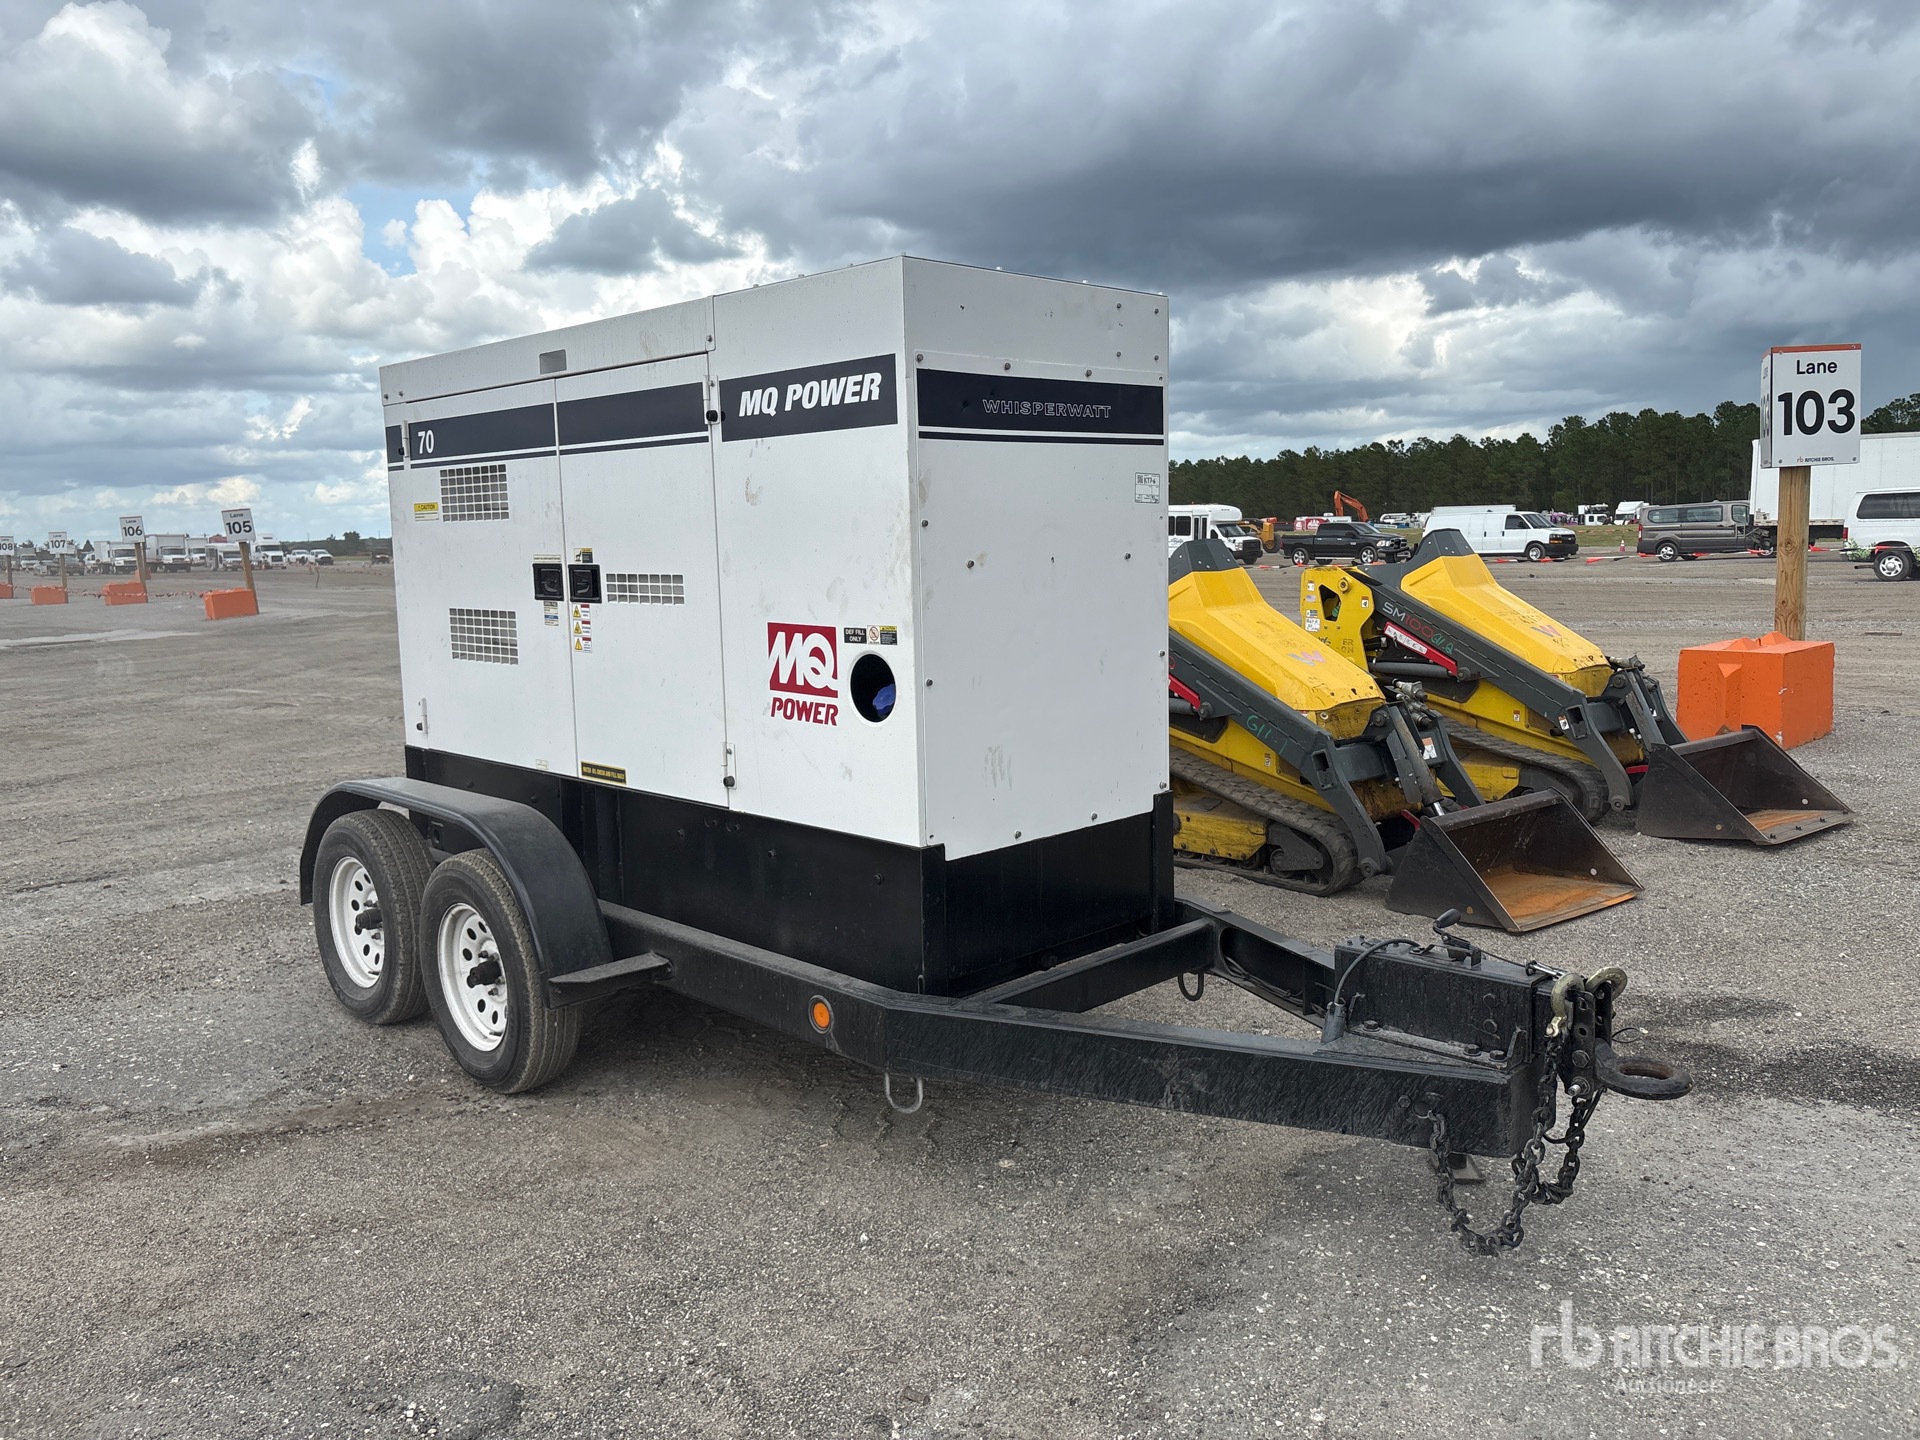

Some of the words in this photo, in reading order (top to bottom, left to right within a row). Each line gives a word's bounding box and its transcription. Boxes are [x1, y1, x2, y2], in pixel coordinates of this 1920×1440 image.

[1796, 359, 1838, 375] Lane
[738, 386, 779, 417] MQ
[784, 371, 882, 412] POWER
[982, 399, 1112, 419] WHISPERWATT
[1777, 388, 1856, 436] 103
[417, 429, 435, 455] 70
[122, 525, 143, 537] 106
[225, 520, 253, 535] 105
[50, 539, 66, 549] 107
[1382, 601, 1434, 639] SM100
[768, 631, 838, 689] MQ
[770, 696, 839, 726] POWER
